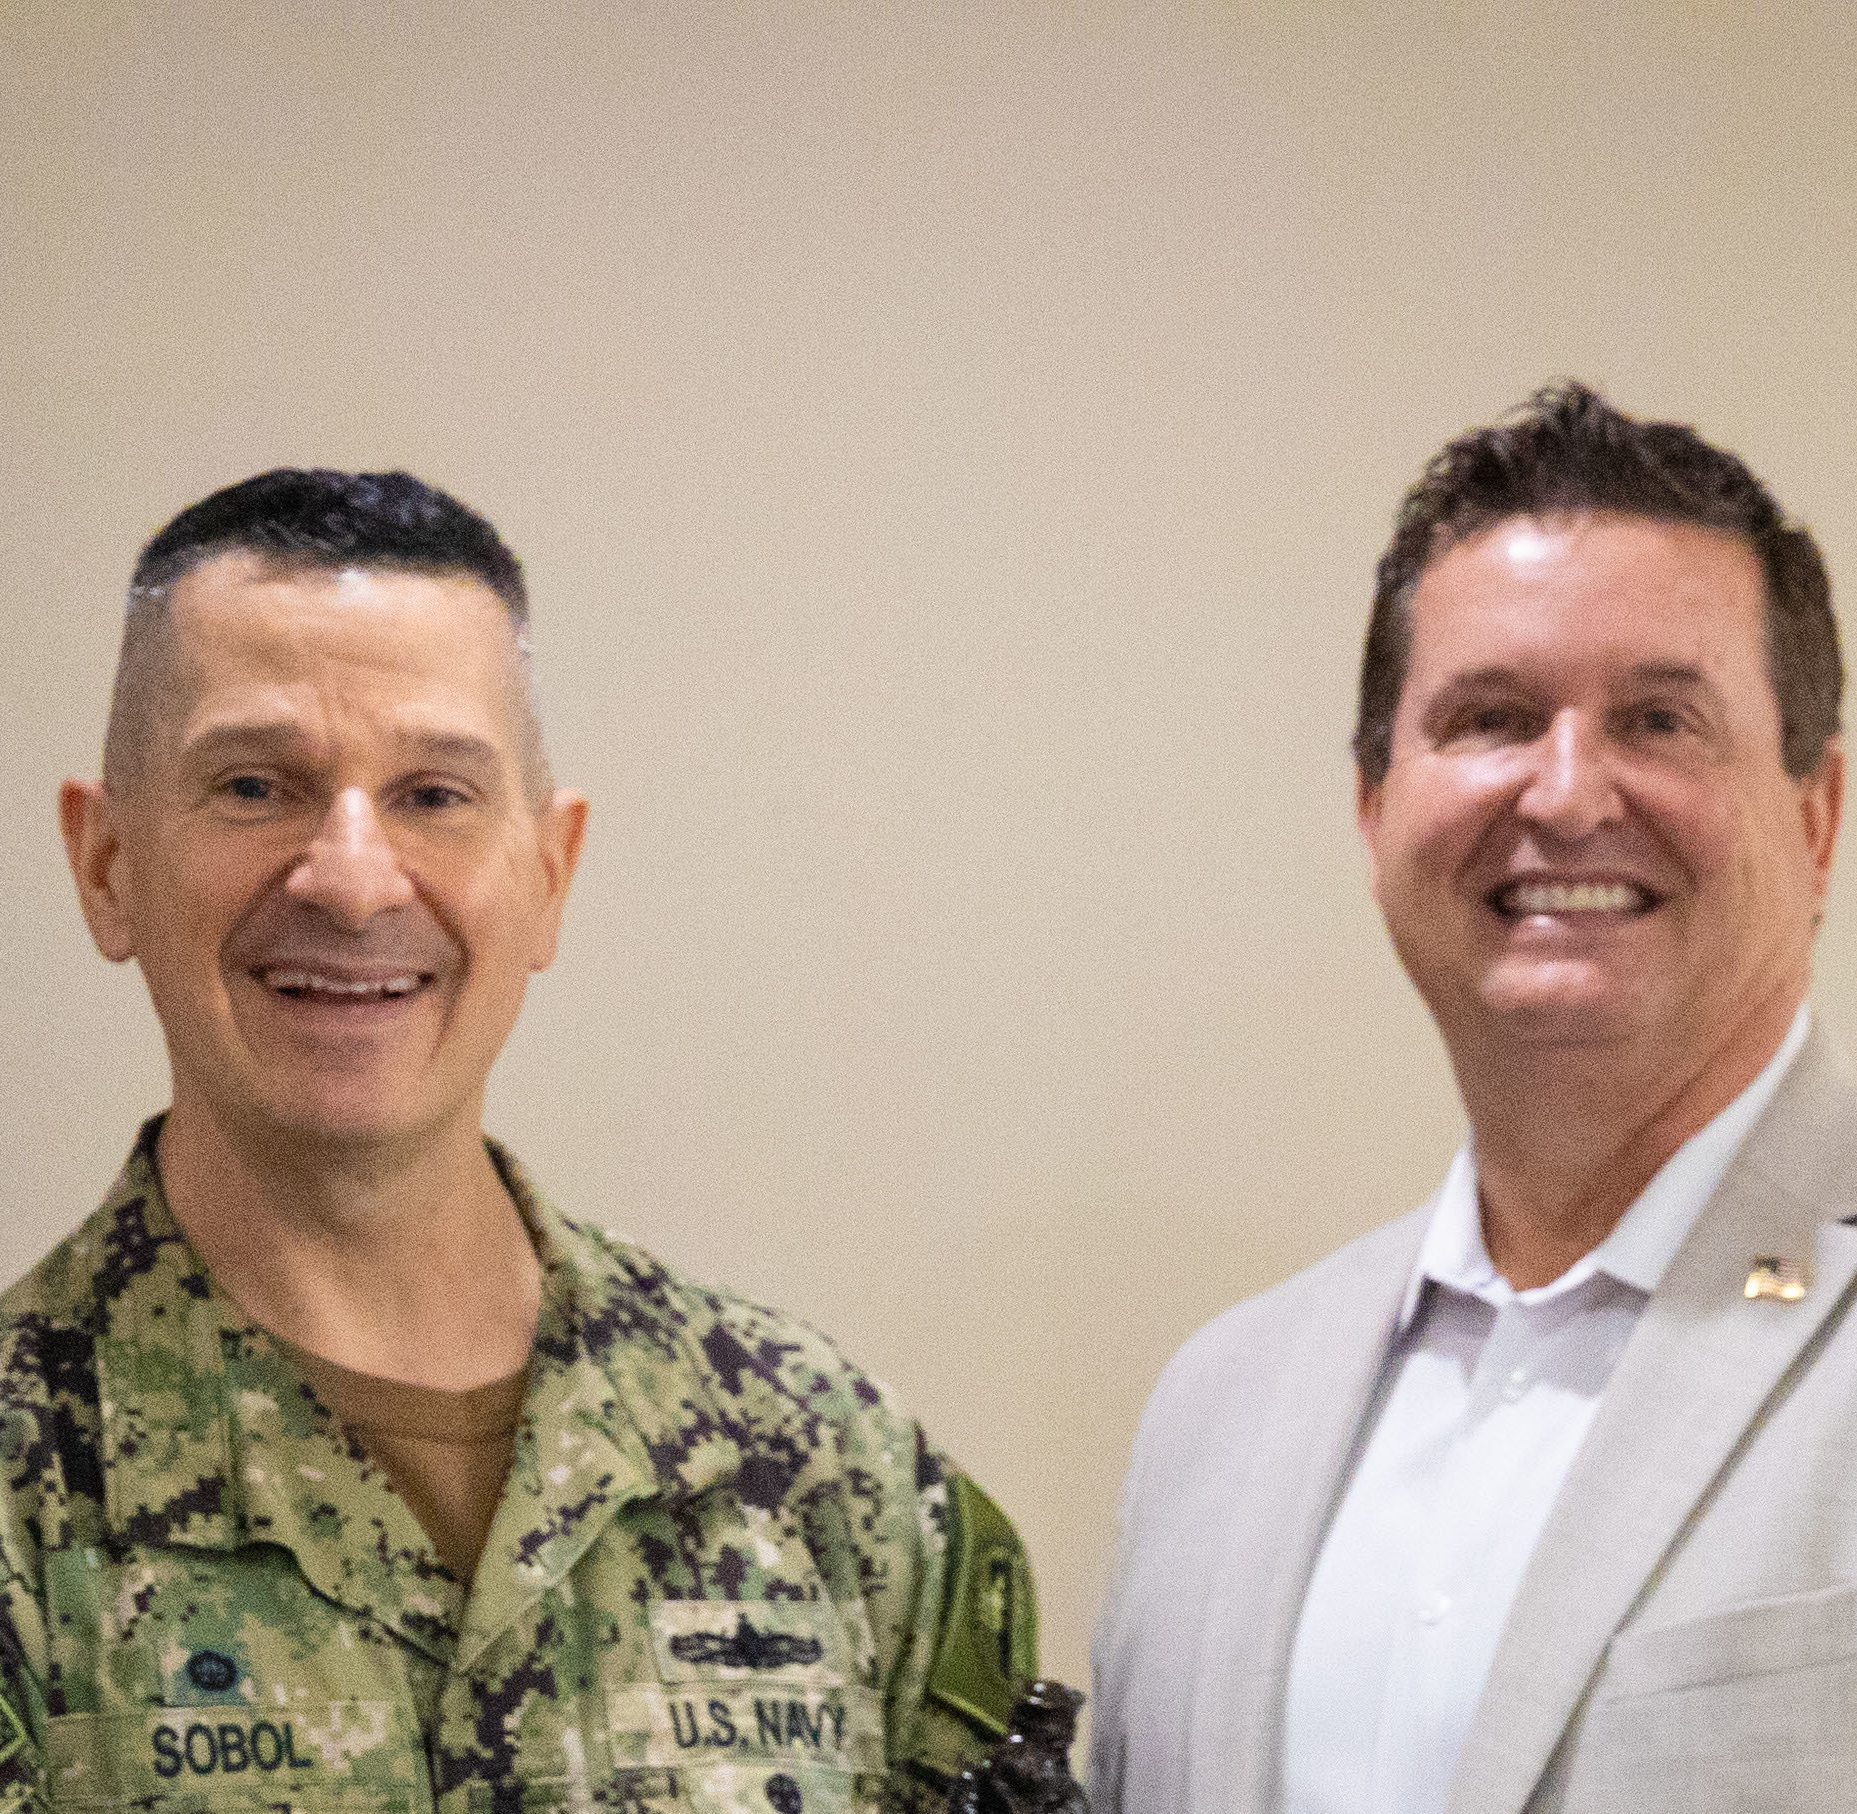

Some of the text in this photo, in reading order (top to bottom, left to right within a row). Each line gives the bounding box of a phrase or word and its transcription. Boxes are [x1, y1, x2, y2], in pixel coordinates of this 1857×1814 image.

[152, 1720, 313, 1779] SOBOL
[669, 1700, 849, 1751] U.S. NAVY
